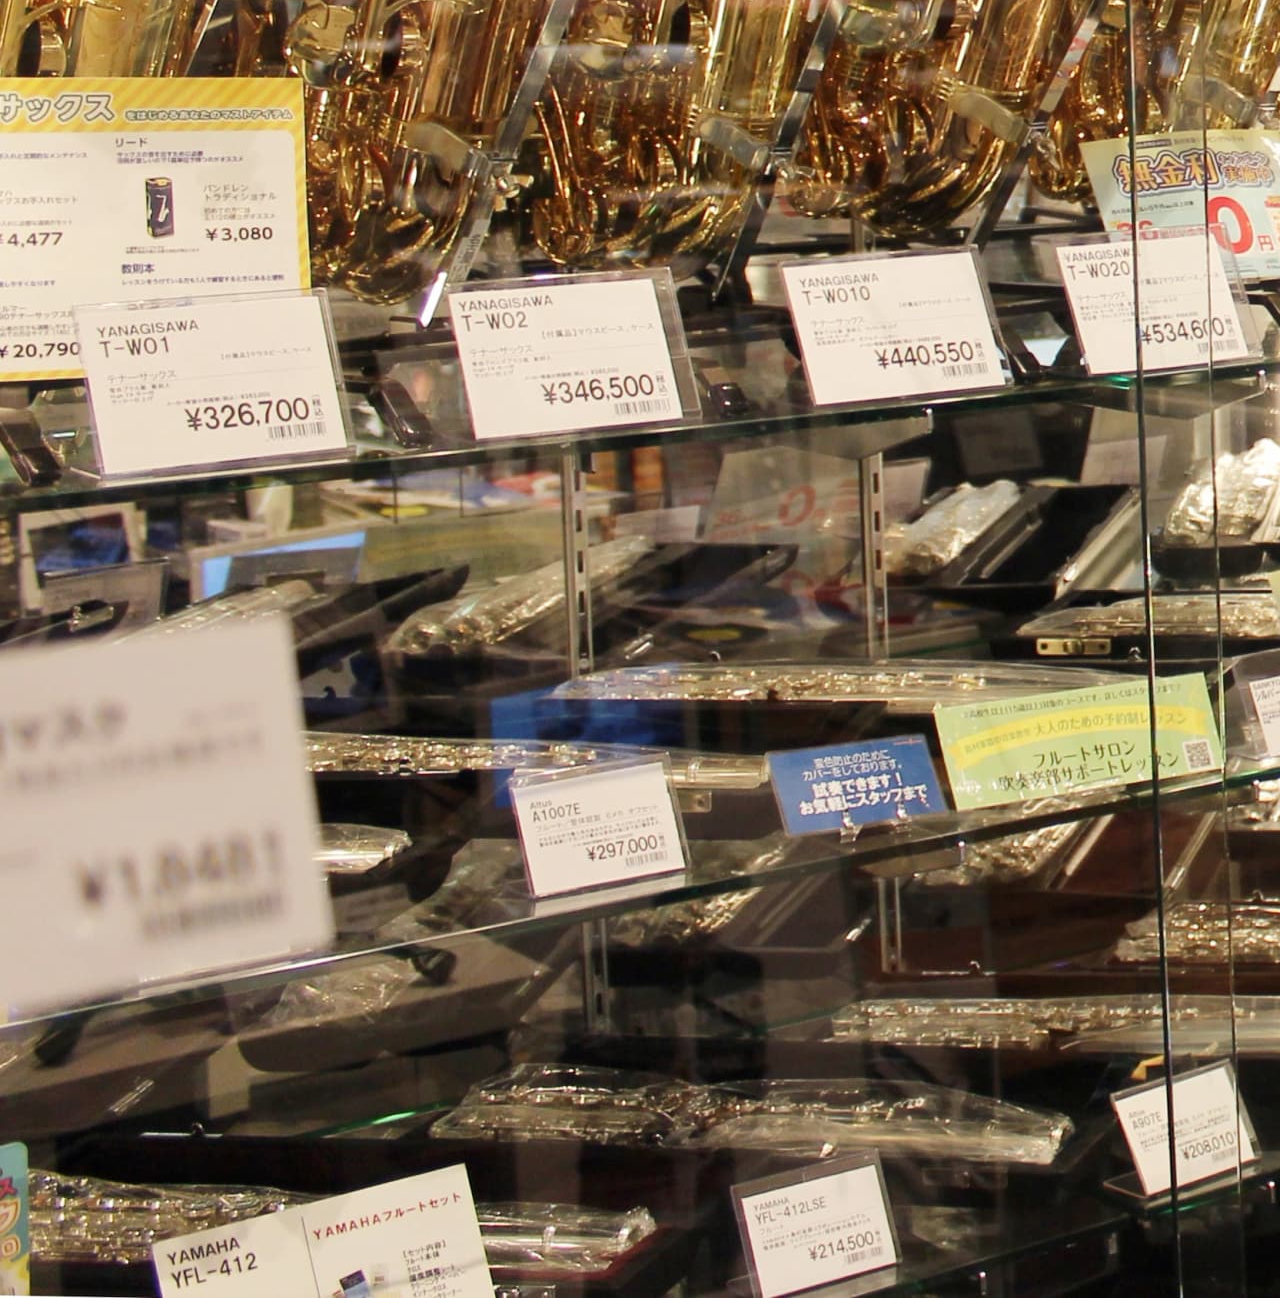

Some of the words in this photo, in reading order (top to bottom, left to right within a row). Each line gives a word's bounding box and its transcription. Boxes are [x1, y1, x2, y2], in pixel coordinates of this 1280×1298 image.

[0, 93, 116, 122] サックス
[114, 137, 148, 148] リード
[1115, 150, 1221, 194] 無金利
[1258, 234, 1274, 251] 円
[1064, 248, 1141, 263] YANAGISAW
[799, 272, 880, 289] YANAGISAWA
[458, 294, 553, 312] YANAGISAWA
[802, 286, 871, 306] T-W010
[97, 319, 199, 338] YANAGISAWA
[461, 311, 528, 333] T-W02
[99, 337, 171, 359] T-W01
[874, 340, 974, 370] ¥440,550
[541, 373, 654, 405] ¥346,500
[185, 397, 309, 431] ¥326,700
[813, 749, 891, 770] 変色防止のために
[1032, 740, 1136, 768] フルートサロン
[812, 773, 902, 797] 試奏できます！
[533, 803, 581, 823] A1007E
[586, 834, 658, 862] ¥297,000
[1132, 1112, 1163, 1130] A907E
[1181, 1132, 1235, 1160] ¥208,010
[313, 1192, 462, 1241] YAMAHAフルートセット
[753, 1198, 790, 1212] YAMAHA
[755, 1197, 827, 1225] YFL-412LSE
[167, 1237, 240, 1266] YAMAHA
[808, 1231, 874, 1261] ¥214,500
[171, 1253, 258, 1289] YFL-412
